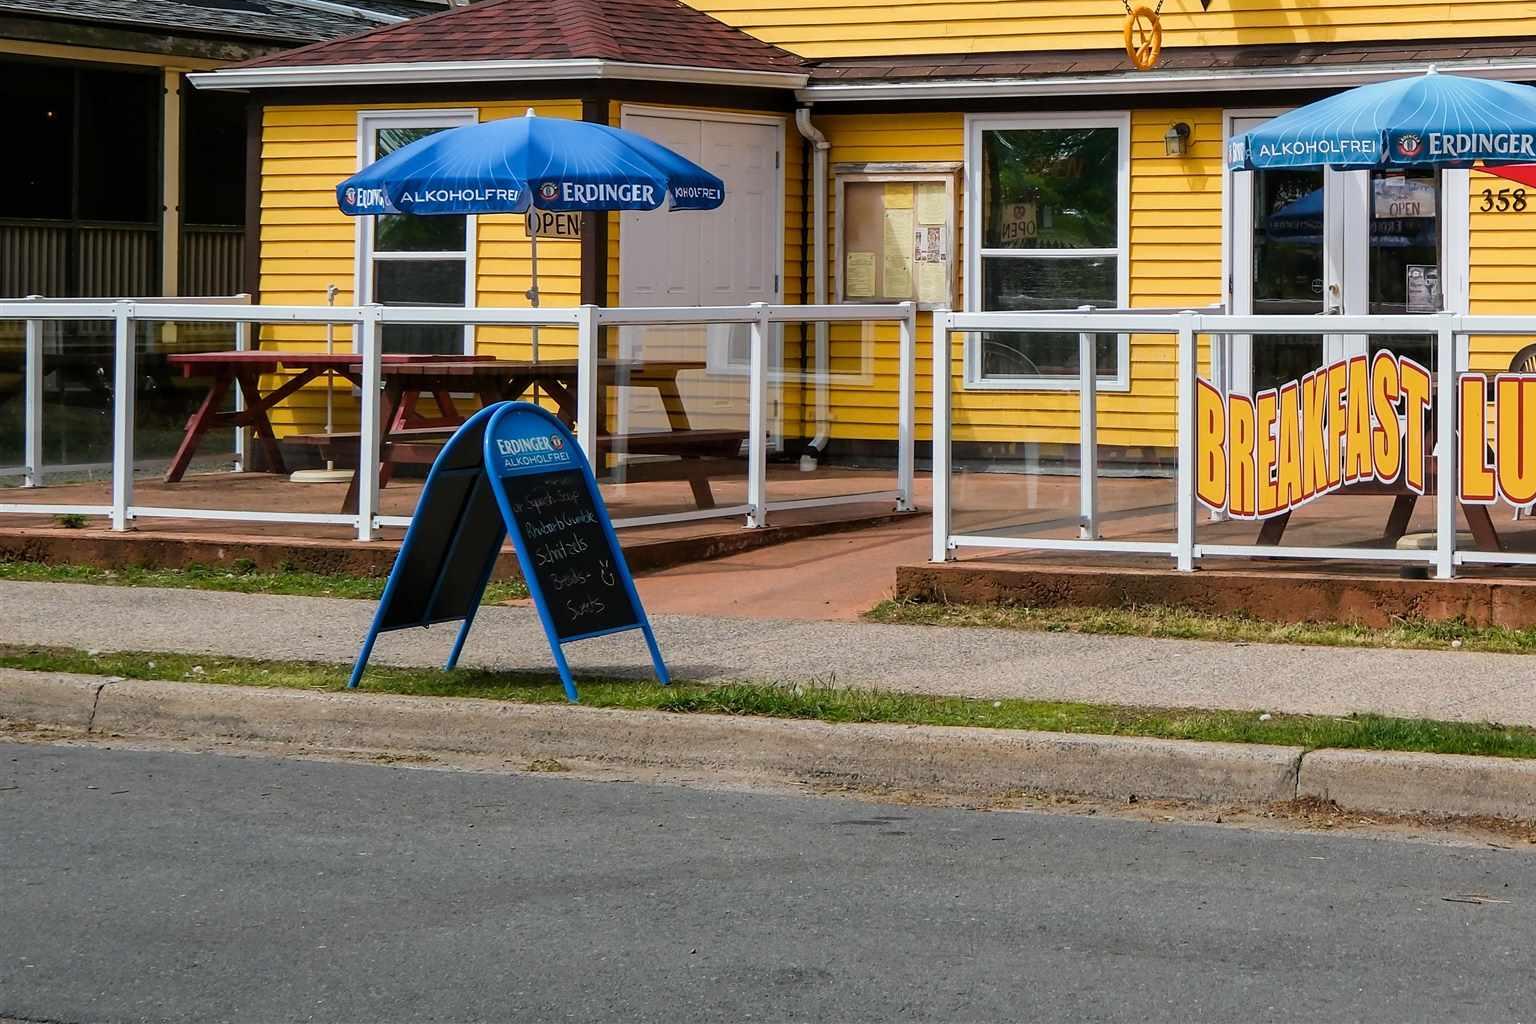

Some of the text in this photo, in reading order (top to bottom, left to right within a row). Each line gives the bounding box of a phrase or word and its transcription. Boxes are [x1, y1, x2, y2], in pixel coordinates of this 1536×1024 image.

[1259, 140, 1376, 156] ALKOHOLFREI
[1429, 133, 1536, 157] ERDINGER
[400, 189, 519, 204] ALKOHOLFREI
[562, 182, 656, 205] ERDINGER
[1480, 188, 1528, 212] 358
[1389, 202, 1421, 217] OPEN
[527, 212, 580, 236] OPEN
[1195, 349, 1432, 519] BREAKFAST
[496, 437, 552, 455] ERDINGER
[504, 452, 570, 467] ALKOHOLFREI
